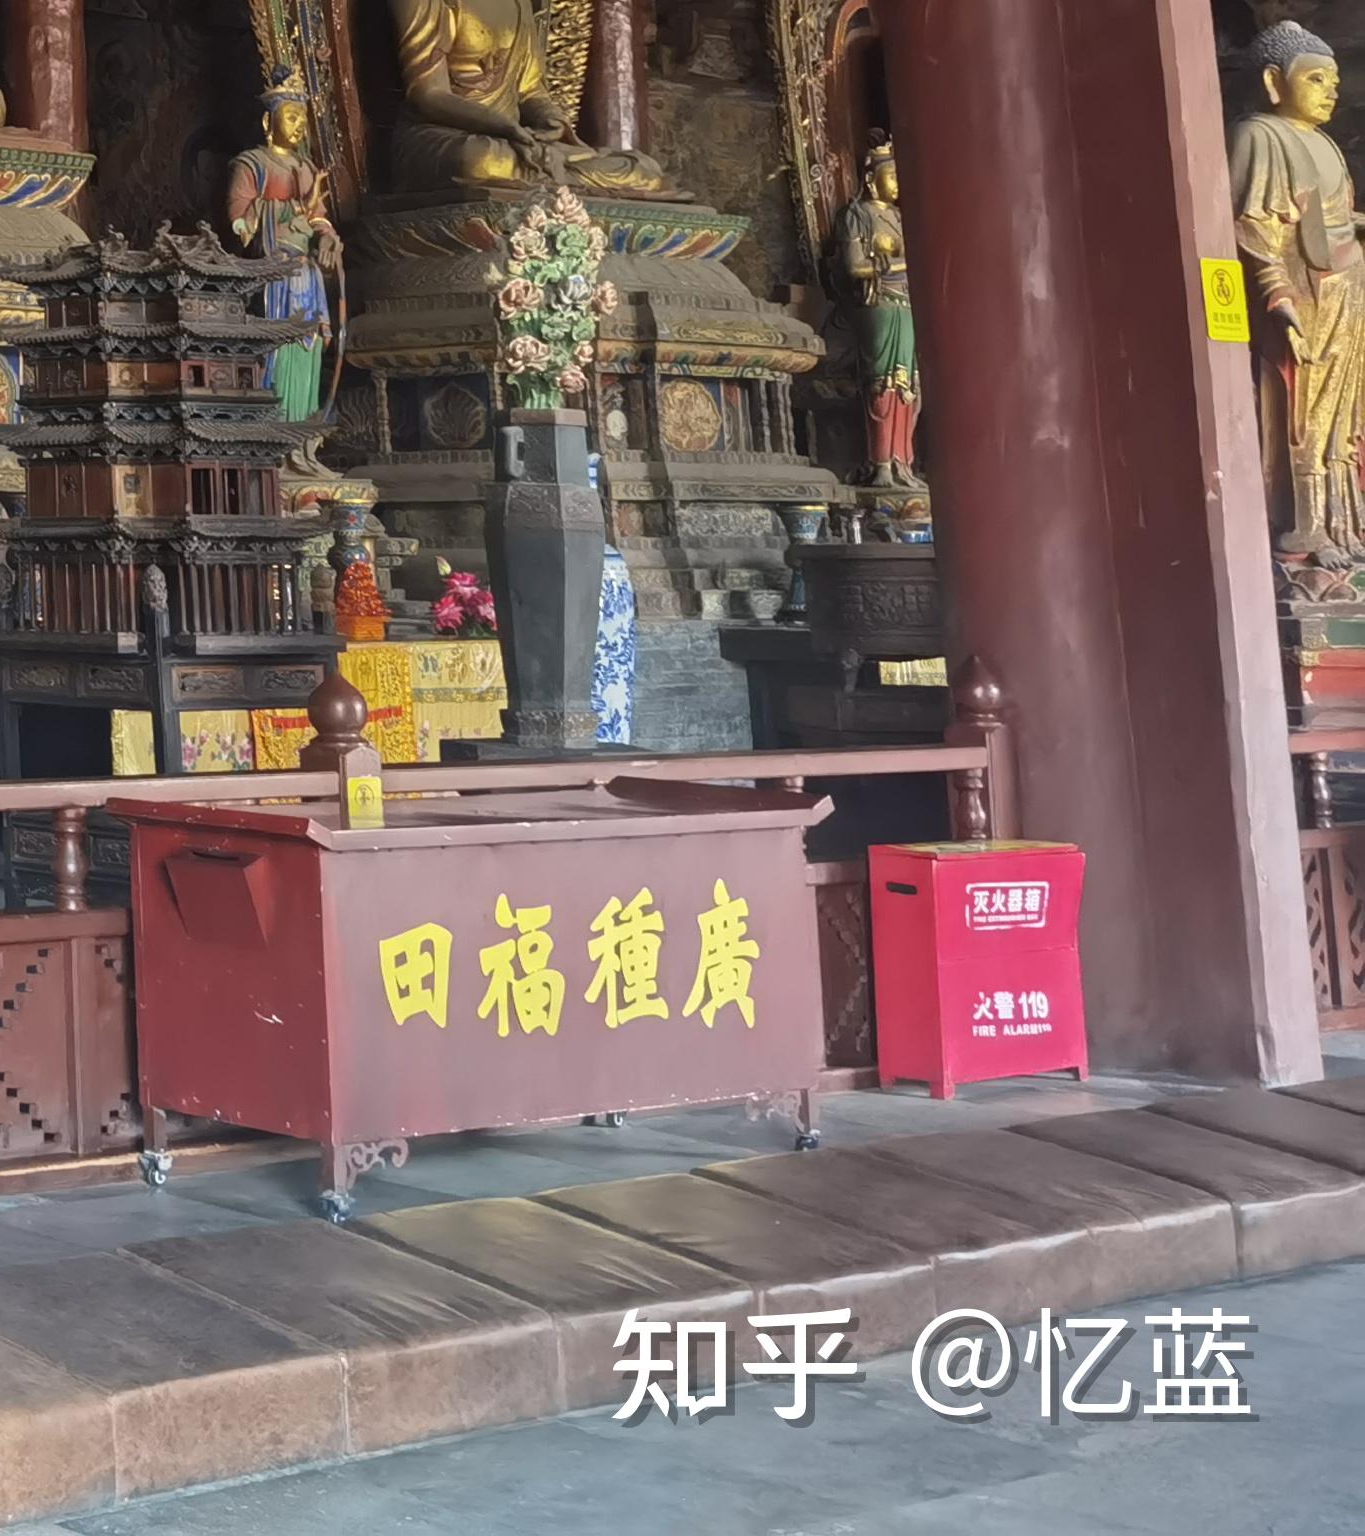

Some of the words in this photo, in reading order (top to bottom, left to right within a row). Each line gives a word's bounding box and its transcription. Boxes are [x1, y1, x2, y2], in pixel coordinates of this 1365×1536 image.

[973, 888, 1041, 914] 灭火器箱
[972, 1025, 996, 1037] FIRE
